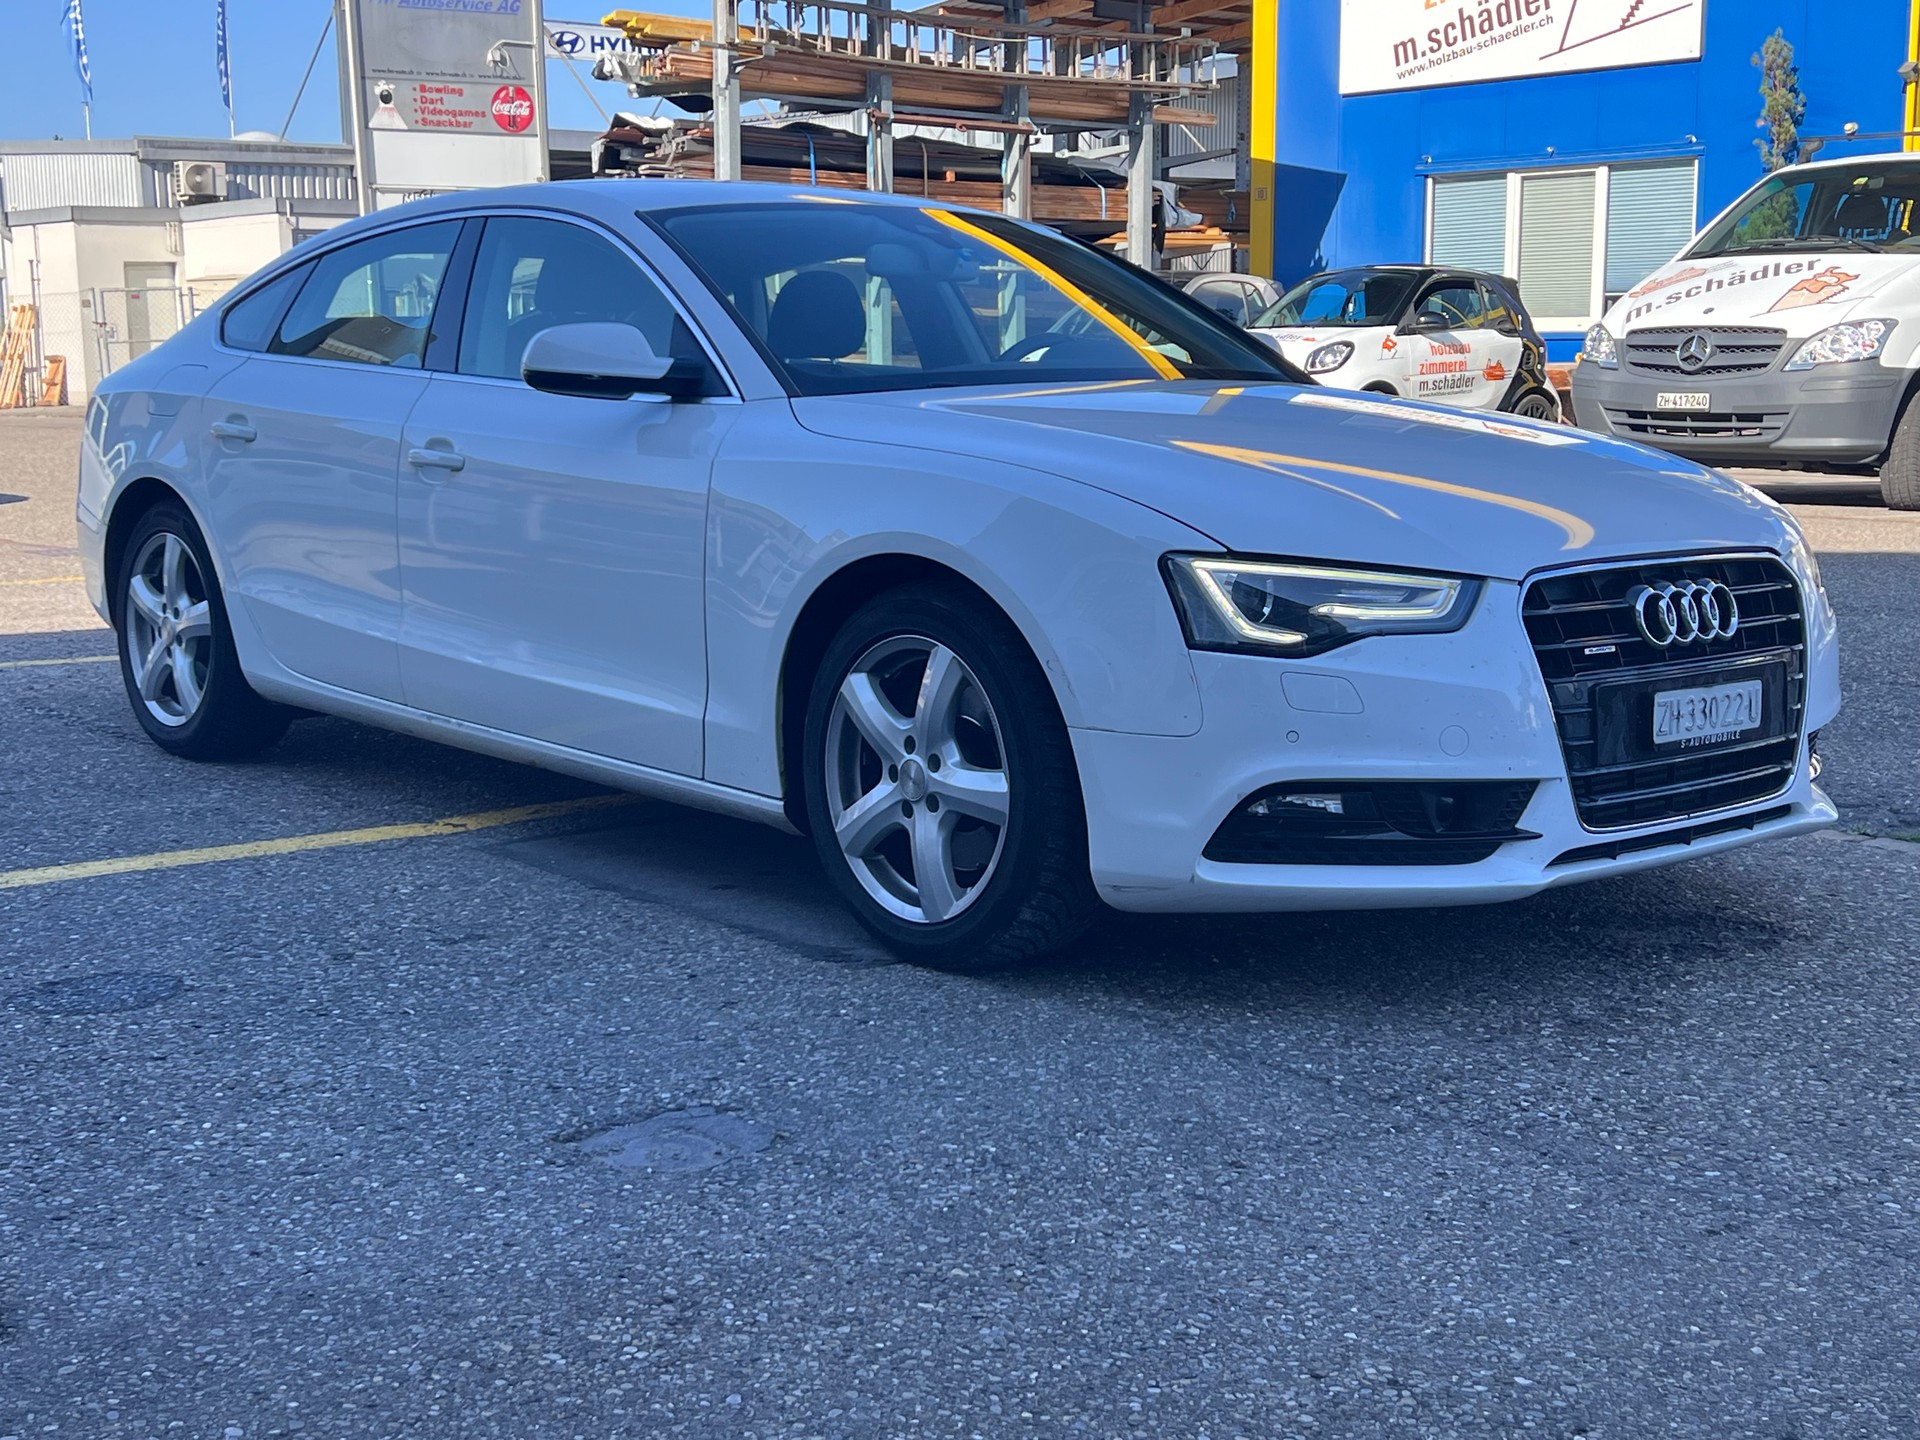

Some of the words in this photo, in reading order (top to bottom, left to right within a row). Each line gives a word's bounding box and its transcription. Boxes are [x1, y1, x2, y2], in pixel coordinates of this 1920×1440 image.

[496, 0, 521, 14] AG
[1396, 14, 1554, 80] www.holzbau-schaedler.ch
[418, 84, 464, 97] Bowling
[420, 95, 445, 105] Dart
[419, 106, 487, 118] Videogames
[420, 117, 473, 128] Snackbar
[1625, 258, 1821, 325] m.schädler
[1429, 342, 1471, 356] holzbau
[1419, 357, 1468, 376] zimmerei
[1419, 374, 1476, 392] m.schädler
[1680, 730, 1741, 748] S-AUTOMOBILE
